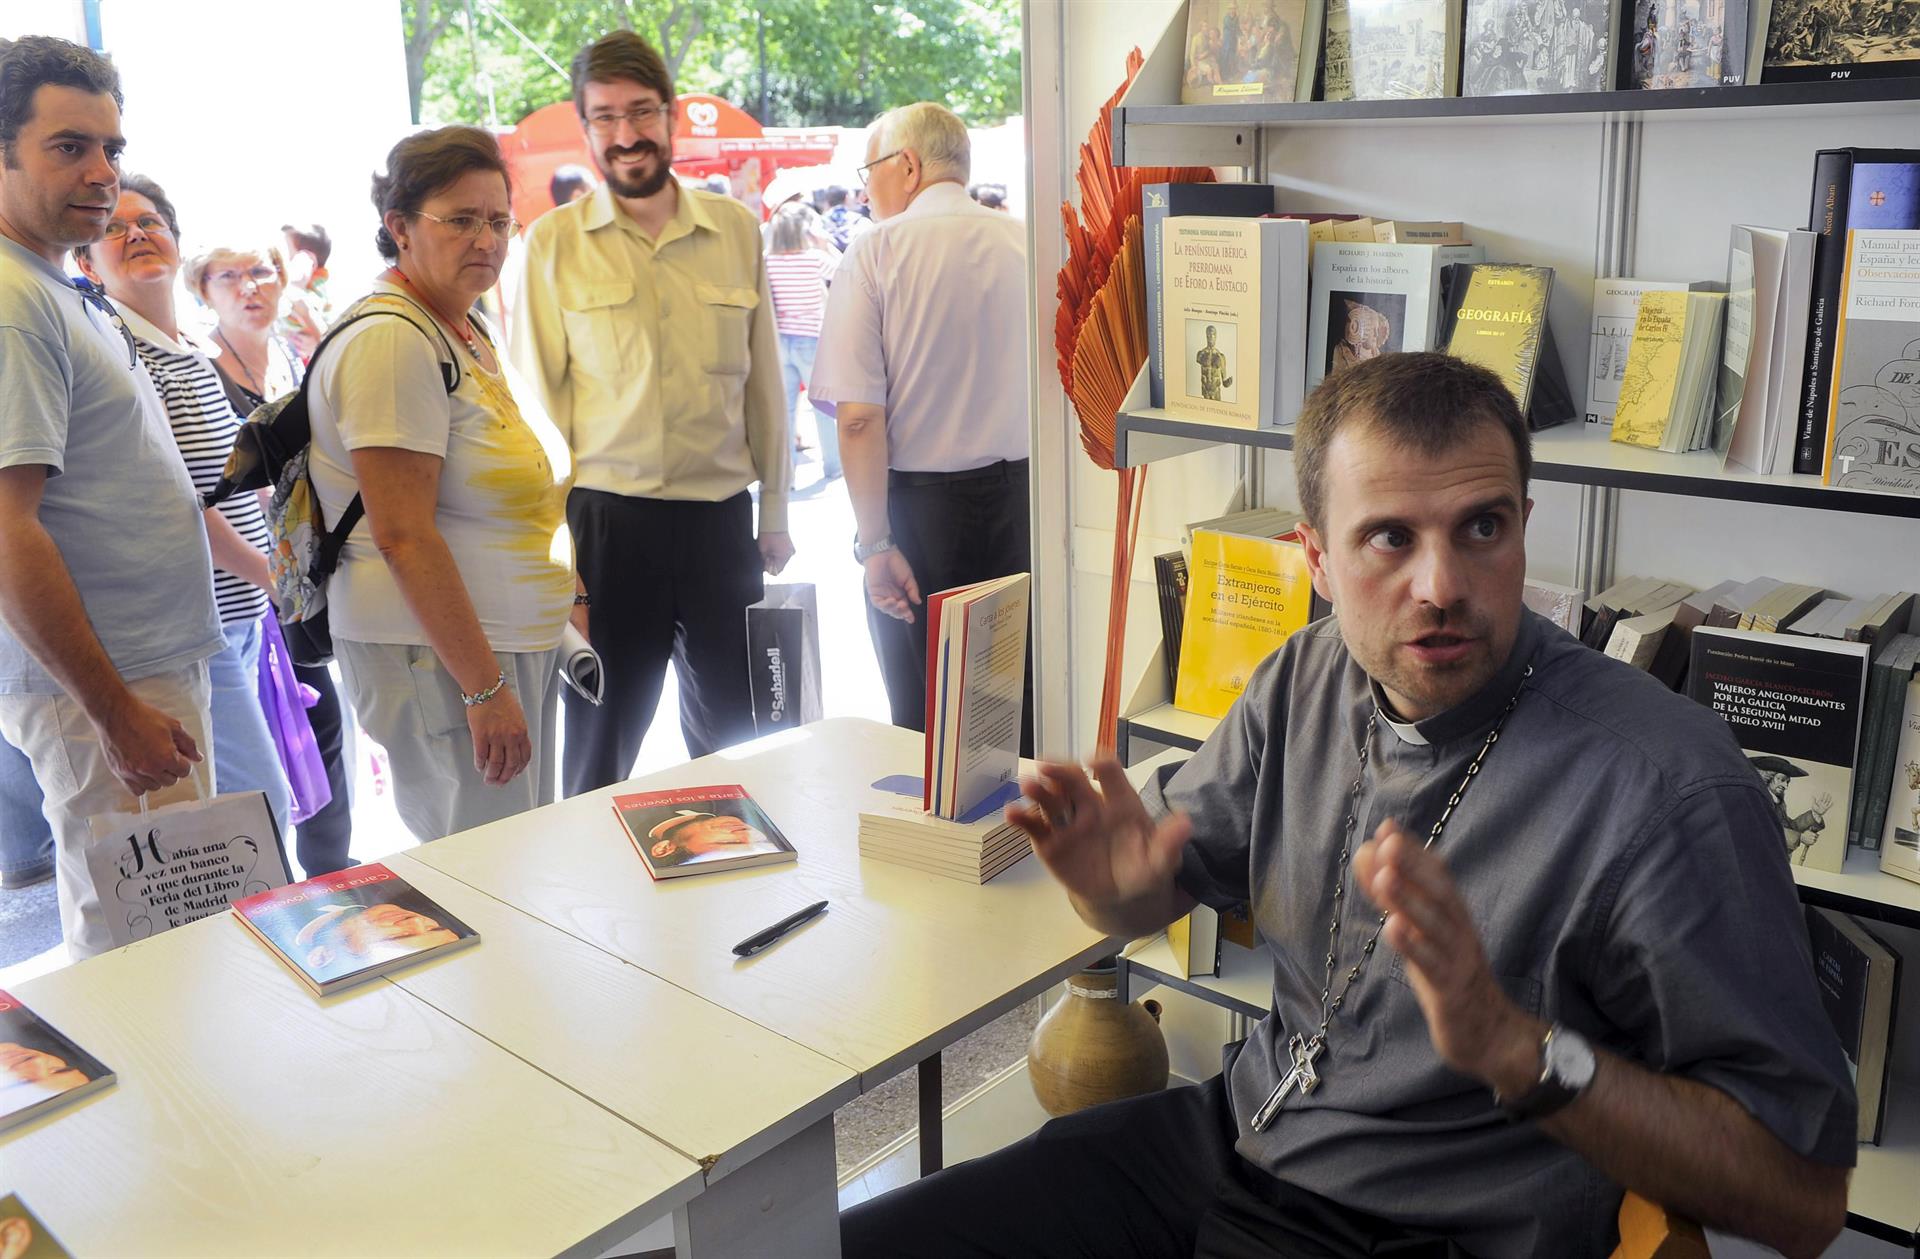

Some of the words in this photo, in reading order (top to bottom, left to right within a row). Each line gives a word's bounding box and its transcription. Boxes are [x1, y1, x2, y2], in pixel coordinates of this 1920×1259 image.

[1723, 75, 1741, 83] PUV
[1830, 71, 1851, 79] PUV
[1826, 184, 1836, 210] Albani
[1823, 211, 1834, 236] Nicola
[1860, 240, 1900, 249] Manual
[1189, 262, 1233, 275] PRERROMANA
[1331, 263, 1357, 274] España
[1370, 265, 1382, 273] los
[1382, 264, 1409, 275] albores
[1860, 254, 1896, 266] España
[1899, 257, 1905, 265] y
[1346, 275, 1356, 283] de
[1357, 275, 1364, 284] la
[1365, 276, 1393, 285] historia
[1855, 296, 1896, 307] Richard
[1457, 308, 1533, 324] GEOGRAFÍA
[1815, 298, 1825, 326] Galicia
[1814, 327, 1822, 336] de
[1810, 337, 1823, 371] Santiago
[1888, 371, 1914, 385] DE
[1806, 377, 1818, 408] Nápoles
[1805, 409, 1813, 420] de
[1803, 420, 1812, 440] Viaxe
[1217, 574, 1281, 596] Extranjeros
[1210, 591, 1225, 600] en
[1228, 593, 1238, 603] el
[1241, 594, 1285, 612] Ejército
[767, 648, 784, 711] Sabadell
[1713, 692, 1733, 702] POR
[1734, 694, 1746, 704] LA
[1747, 697, 1786, 711] GALICIA
[1714, 682, 1756, 696] VIAJEROS
[1757, 690, 1846, 711] ANGLOPARLANTES
[1713, 701, 1726, 711] DE
[1727, 704, 1739, 713] LA
[1740, 706, 1787, 721] SEGUNDA
[1788, 714, 1822, 727] MITAD
[1731, 713, 1760, 727] SIGLO
[1761, 718, 1785, 731] XVIII
[710, 792, 744, 800] Carta
[120, 828, 199, 878] Había
[202, 841, 228, 854] una
[144, 869, 167, 881] vez
[170, 864, 187, 875] un
[190, 854, 230, 871] banco
[140, 885, 152, 896] al
[156, 880, 179, 893] que
[181, 866, 229, 886] durante
[231, 864, 244, 874] la
[348, 873, 390, 886] Carta
[148, 891, 180, 907] Feria
[182, 885, 202, 899] del
[205, 880, 240, 894] Libro
[164, 906, 180, 916] de
[183, 894, 228, 912] Madrid
[168, 918, 180, 928] le
